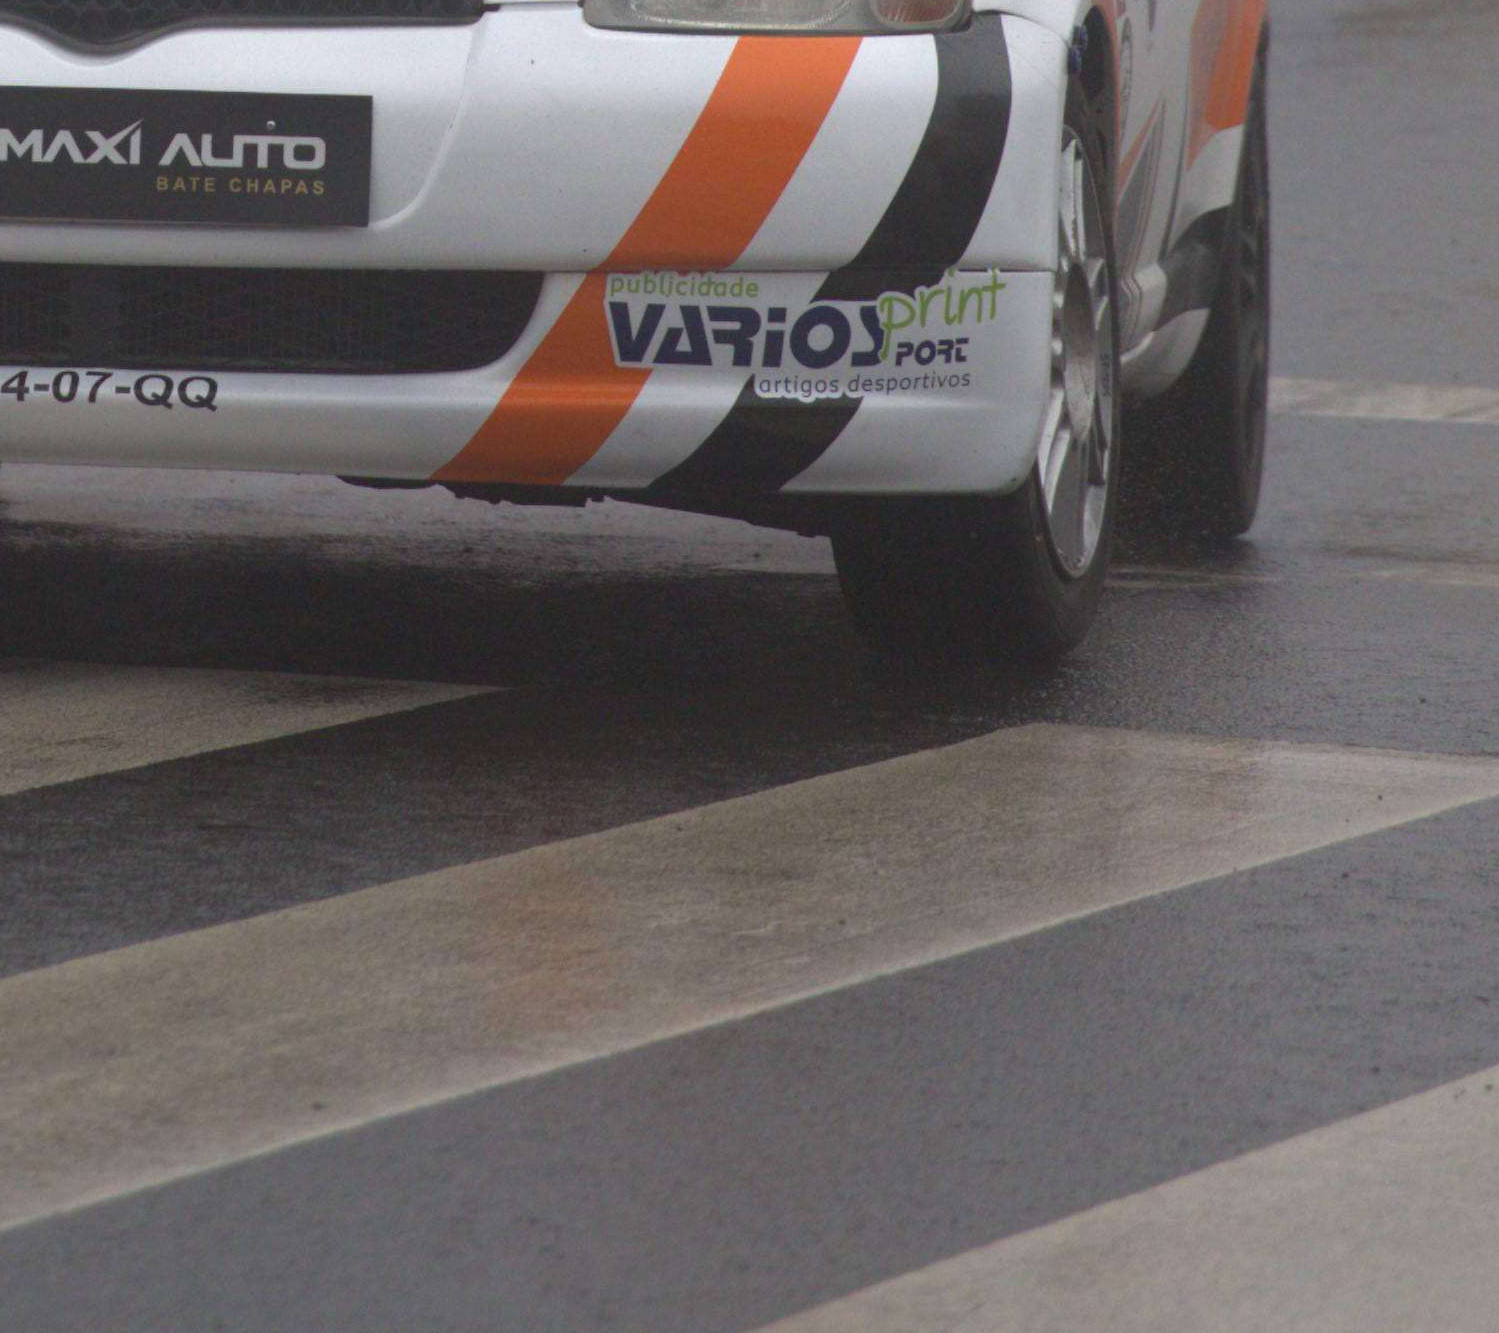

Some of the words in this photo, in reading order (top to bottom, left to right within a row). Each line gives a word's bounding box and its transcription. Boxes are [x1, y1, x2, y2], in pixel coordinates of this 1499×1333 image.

[158, 132, 328, 170] AUTO
[156, 175, 217, 193] BATE
[228, 177, 327, 196] CHAPAS
[608, 272, 761, 298] publicidade
[879, 268, 1007, 361] print
[757, 373, 840, 397] artigos
[847, 371, 972, 396] desportivos
